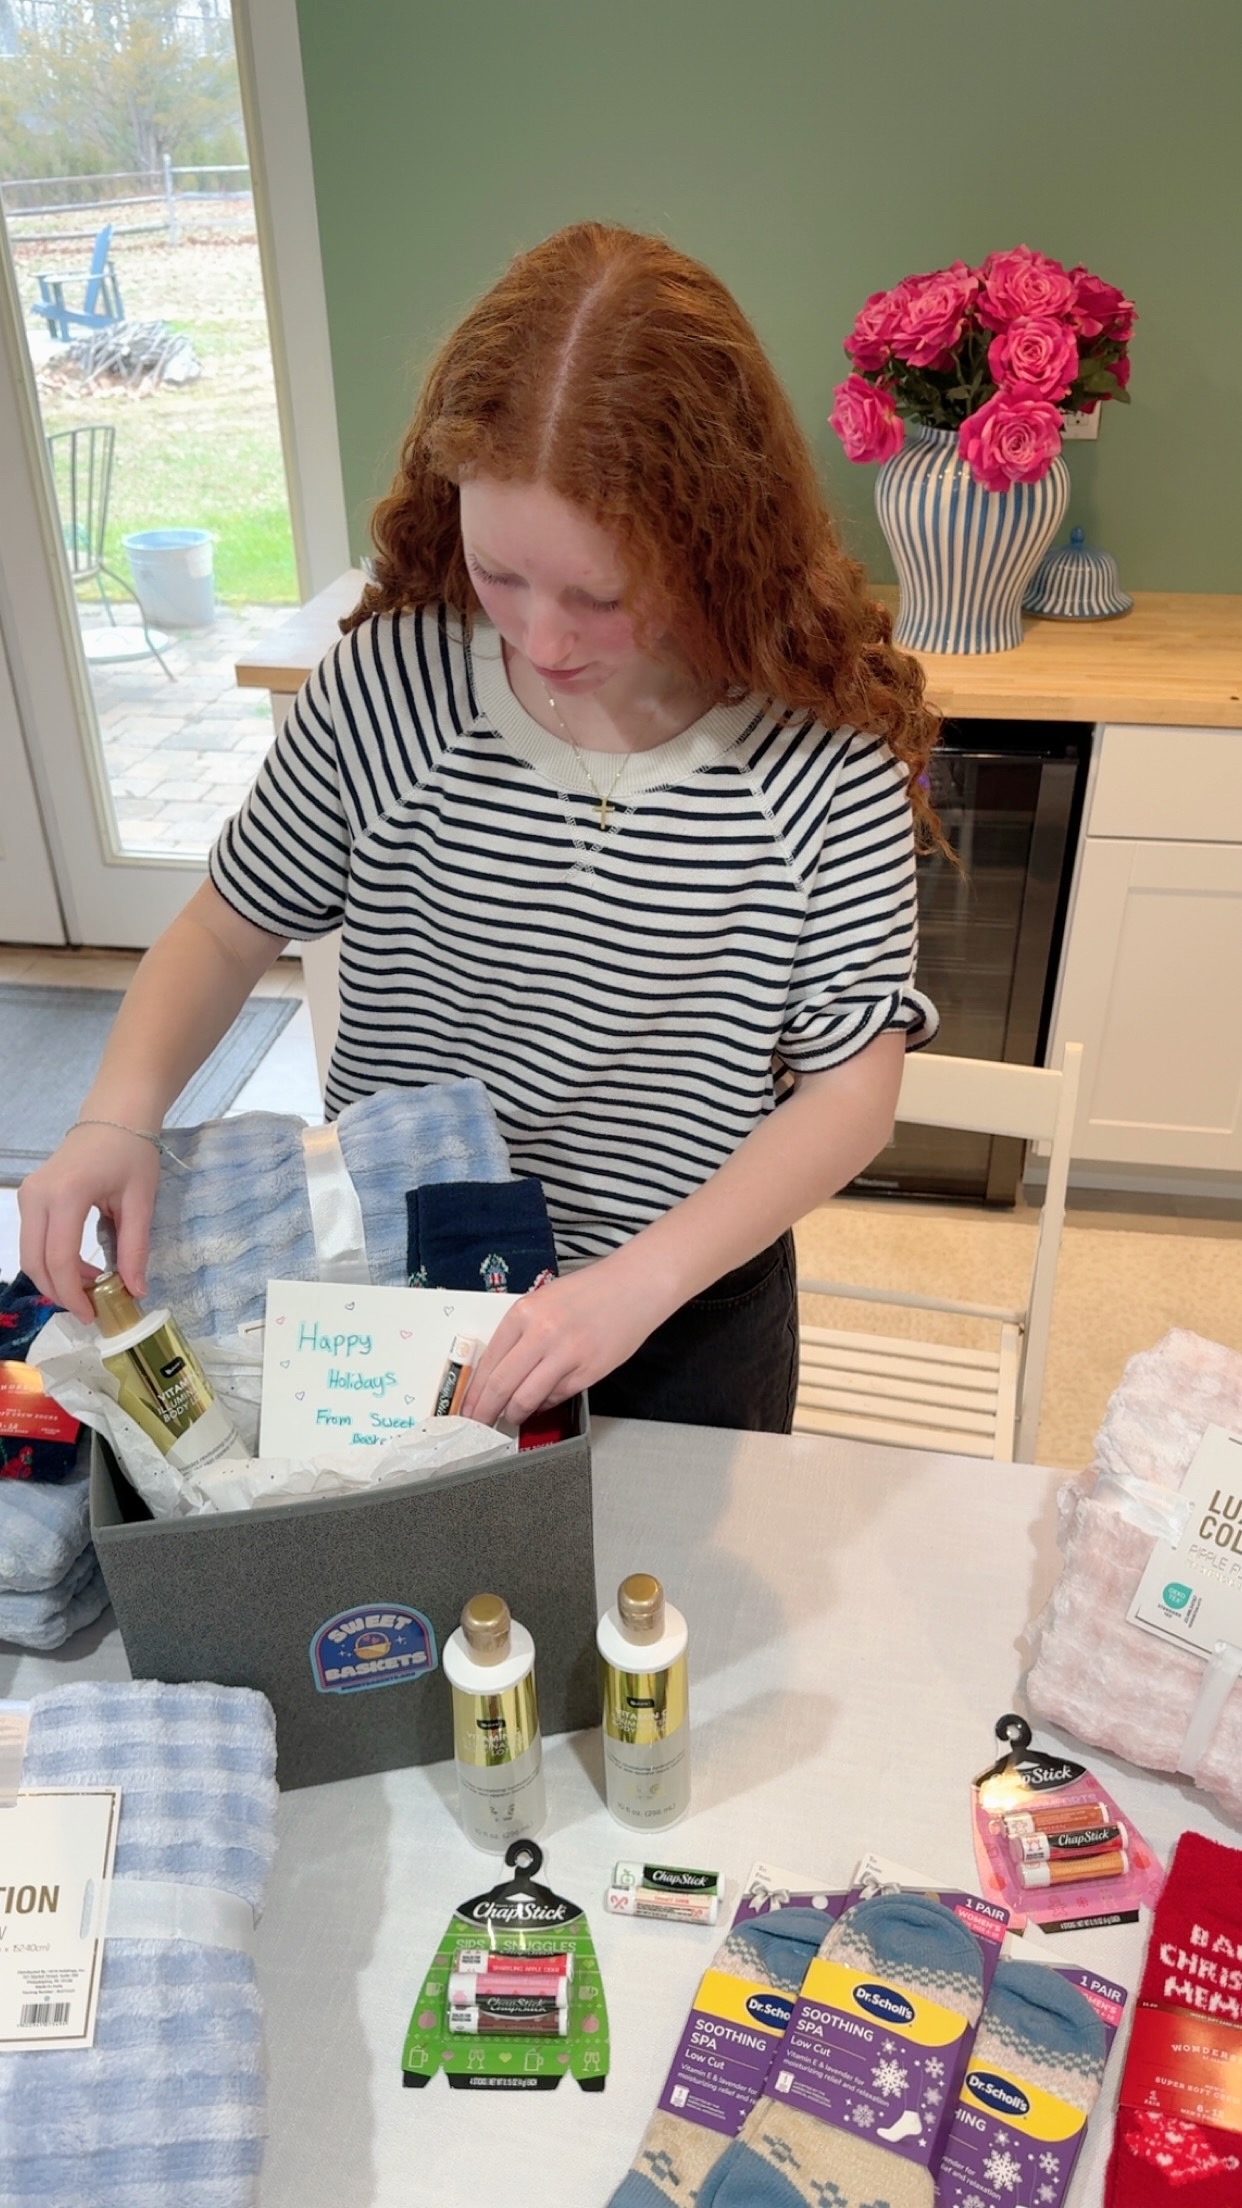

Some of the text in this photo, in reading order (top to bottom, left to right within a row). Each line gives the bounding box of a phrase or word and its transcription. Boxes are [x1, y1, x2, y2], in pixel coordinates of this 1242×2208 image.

[298, 1321, 373, 1357] Happy
[327, 1368, 397, 1398] Holidays
[436, 1371, 457, 1416] ChapStic
[163, 1400, 189, 1423] BODY
[315, 1408, 417, 1429] From Sweet
[1208, 1489, 1242, 1524] LU
[1199, 1515, 1242, 1556] COL
[328, 1614, 413, 1644] SWEET
[325, 1650, 428, 1682] BASKETS
[1058, 1828, 1110, 1847] ChapStick
[652, 1869, 709, 1887] ChapStick
[472, 1901, 566, 1923] ChapStick
[958, 1908, 1001, 1933] WOMEN'S
[965, 1898, 1005, 1922] 1 PAIR
[456, 1938, 486, 1950] SIPS
[503, 1940, 577, 1953] SNUGGLES
[1190, 1923, 1242, 1963] BA
[1160, 1942, 1242, 1992] CHRIS
[856, 1987, 913, 2020] Dr.Scholl's
[1080, 1974, 1122, 2003] 1 PAIR
[1164, 1975, 1242, 2020] MEM
[748, 1998, 791, 2021] Dr.Scho
[801, 2006, 874, 2042] SOOTHING
[690, 2032, 717, 2050] SPA
[694, 2019, 767, 2052] SOOTHING
[796, 2019, 824, 2038] SPA
[684, 2049, 726, 2070] Low Cut
[790, 2035, 832, 2058] Low Cut
[1171, 2044, 1238, 2063] WONDERS
[681, 2063, 758, 2096] Vitamin E & lavender for
[786, 2049, 865, 2086] Vitamin E & lavender for
[677, 2072, 749, 2102] moisturizing relief and
[783, 2058, 890, 2108] moisturizing relief and relaxation
[968, 2075, 1028, 2112] Dr.Scholl's
[1155, 2075, 1185, 2090] SUPER
[1187, 2085, 1212, 2096] SOFT
[951, 2171, 966, 2182] and
[966, 2178, 1001, 2201] relaxation
[964, 2166, 976, 2176] for
